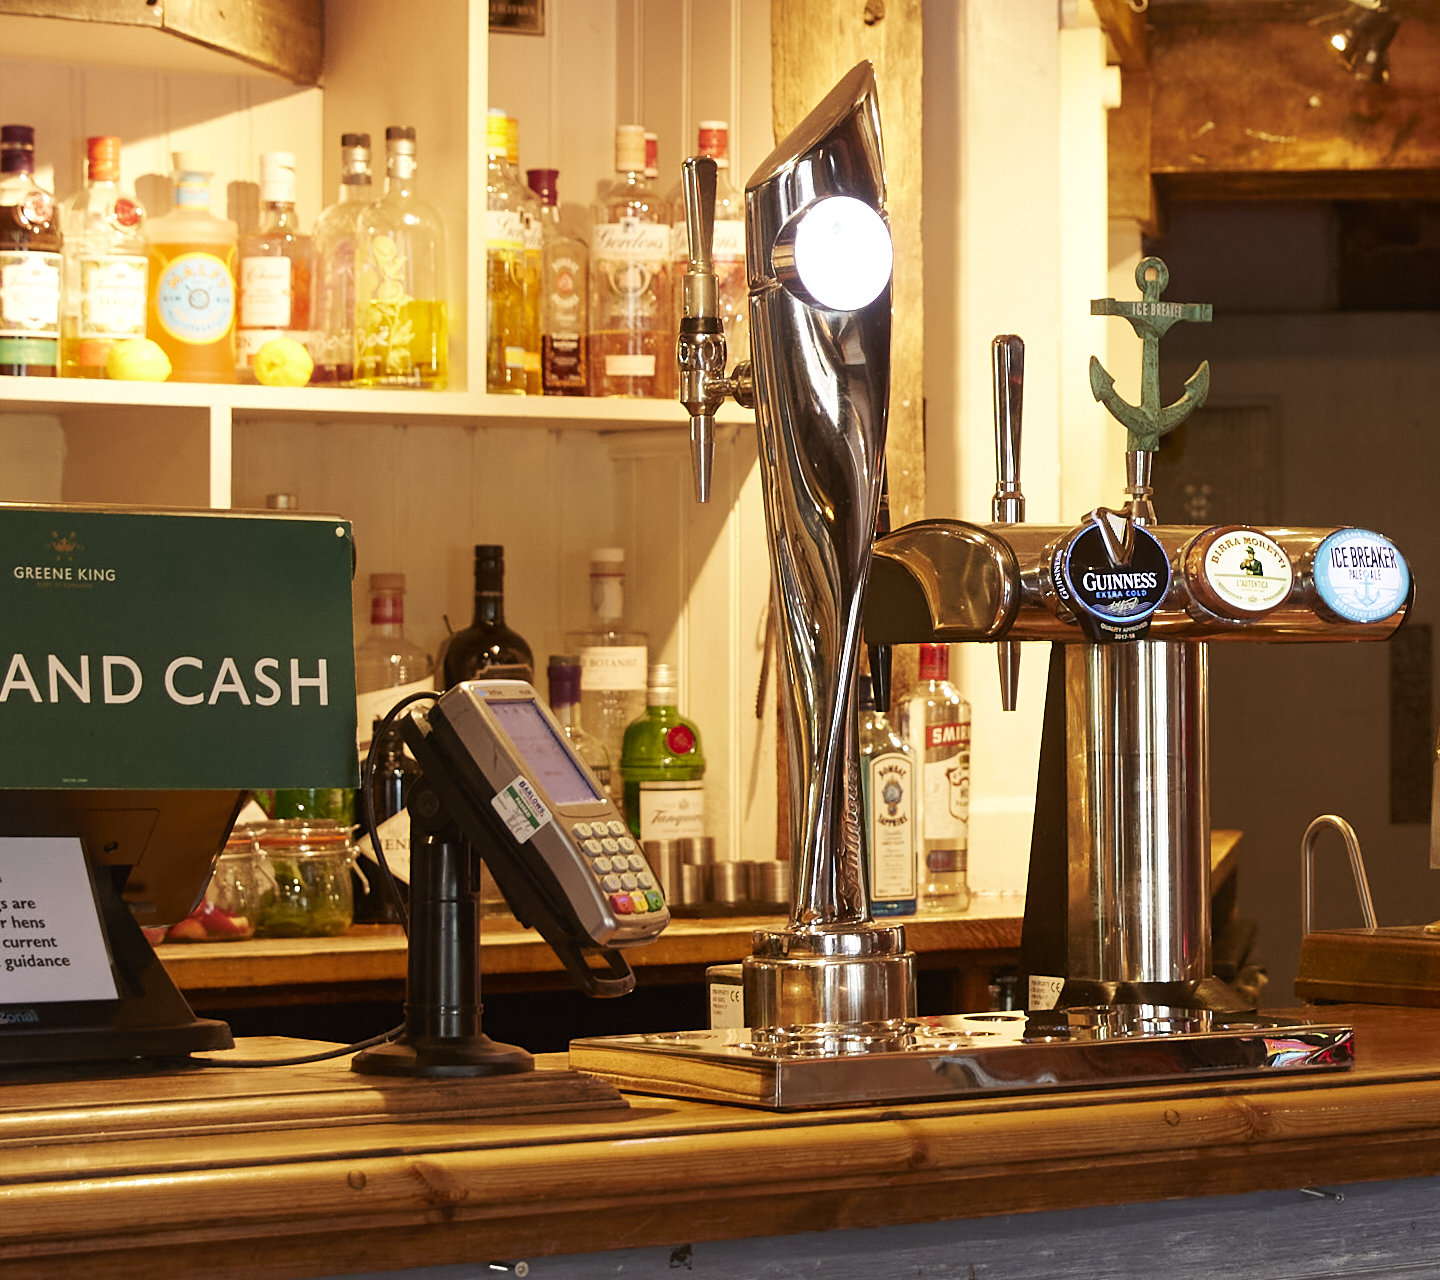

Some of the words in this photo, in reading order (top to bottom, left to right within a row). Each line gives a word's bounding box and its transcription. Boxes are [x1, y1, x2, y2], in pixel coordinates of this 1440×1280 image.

[1132, 303, 1148, 317] ICE
[1151, 303, 1183, 319] BREAKER
[1210, 538, 1242, 565] BIRRA
[1242, 536, 1287, 570] MORETTI
[1330, 547, 1350, 569] ICE
[1350, 546, 1398, 569] BREAKER
[13, 566, 74, 581] GREENE
[77, 568, 117, 582] KING
[1082, 572, 1159, 592] GUINNESS
[1349, 569, 1363, 580] PALE
[1370, 569, 1382, 581] ALE
[1095, 591, 1123, 599] EXTRA
[1125, 590, 1148, 598] COLD
[164, 656, 330, 707] CASH
[12, 898, 37, 910] are
[11, 915, 47, 929] hens
[2, 935, 59, 949] current
[4, 953, 72, 972] guidance
